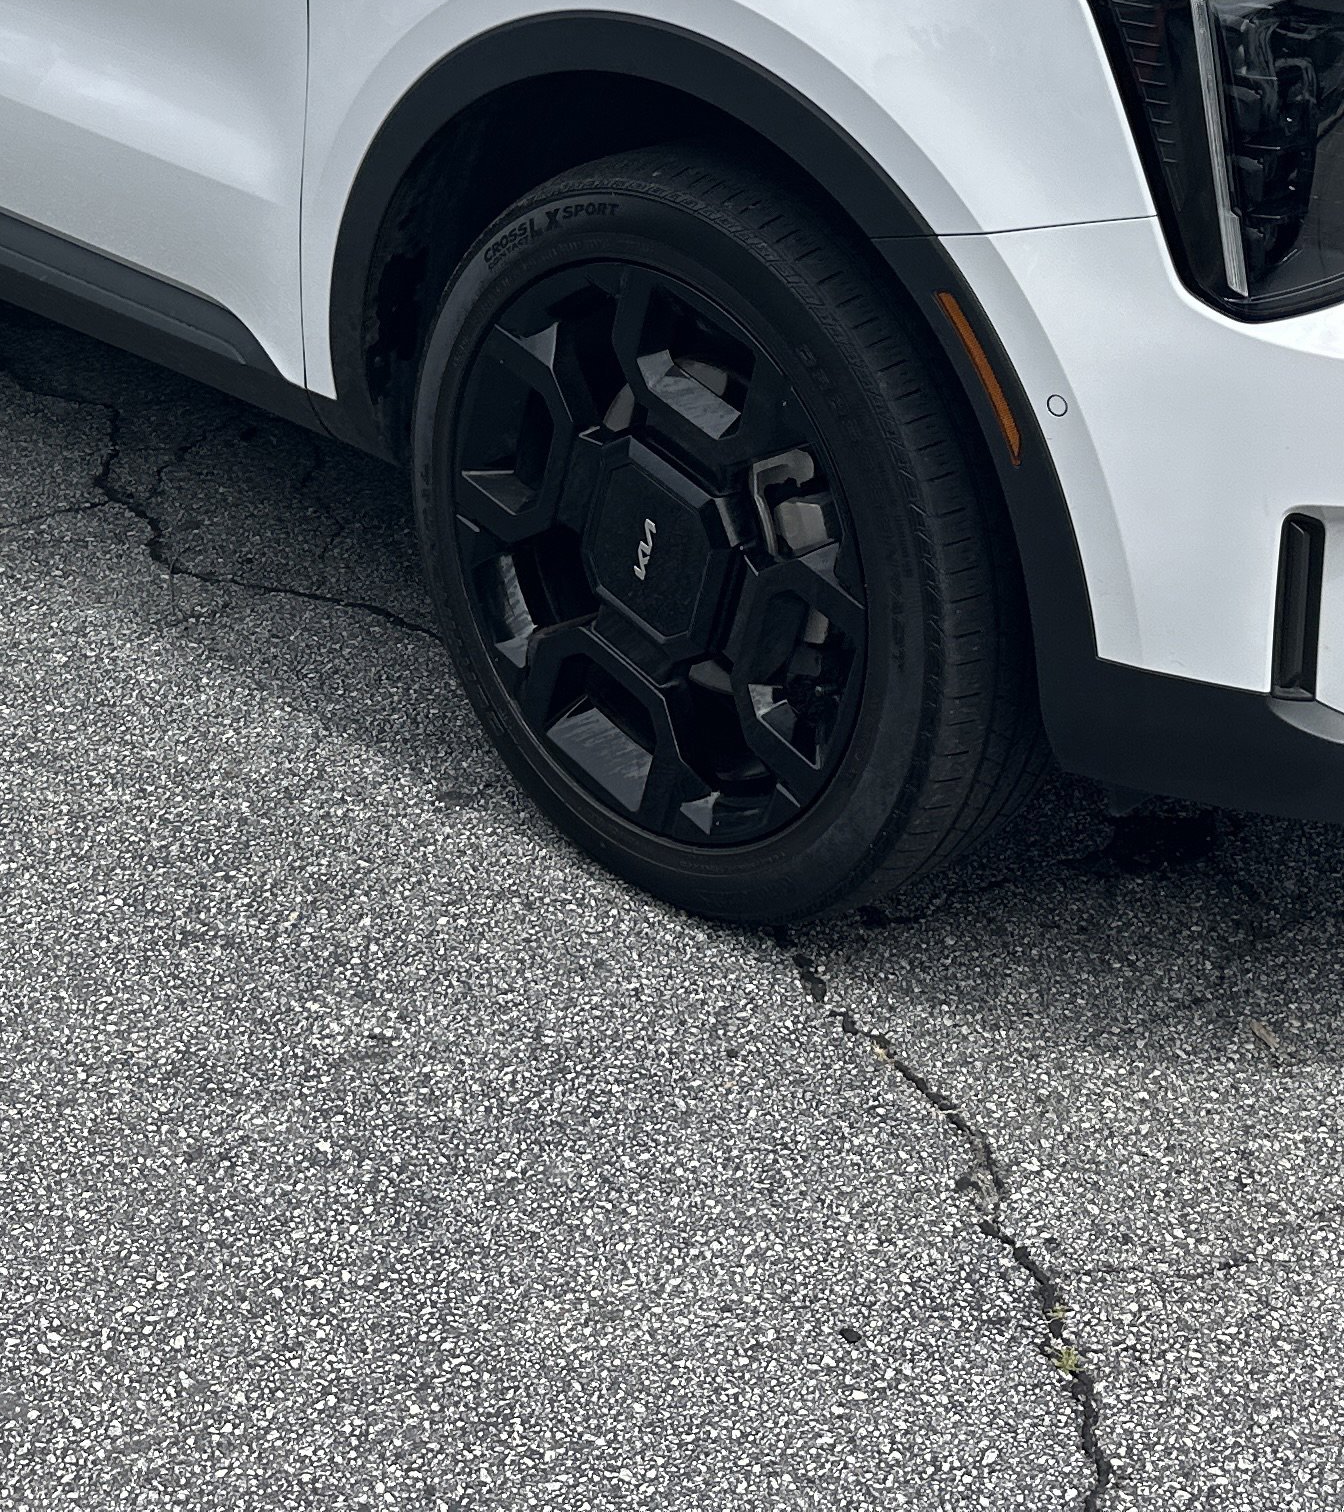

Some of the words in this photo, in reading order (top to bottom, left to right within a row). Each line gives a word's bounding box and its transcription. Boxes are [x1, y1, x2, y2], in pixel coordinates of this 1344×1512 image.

[484, 222, 528, 263] CROSS
[562, 202, 620, 221] SPORT
[633, 518, 657, 581] KIA
